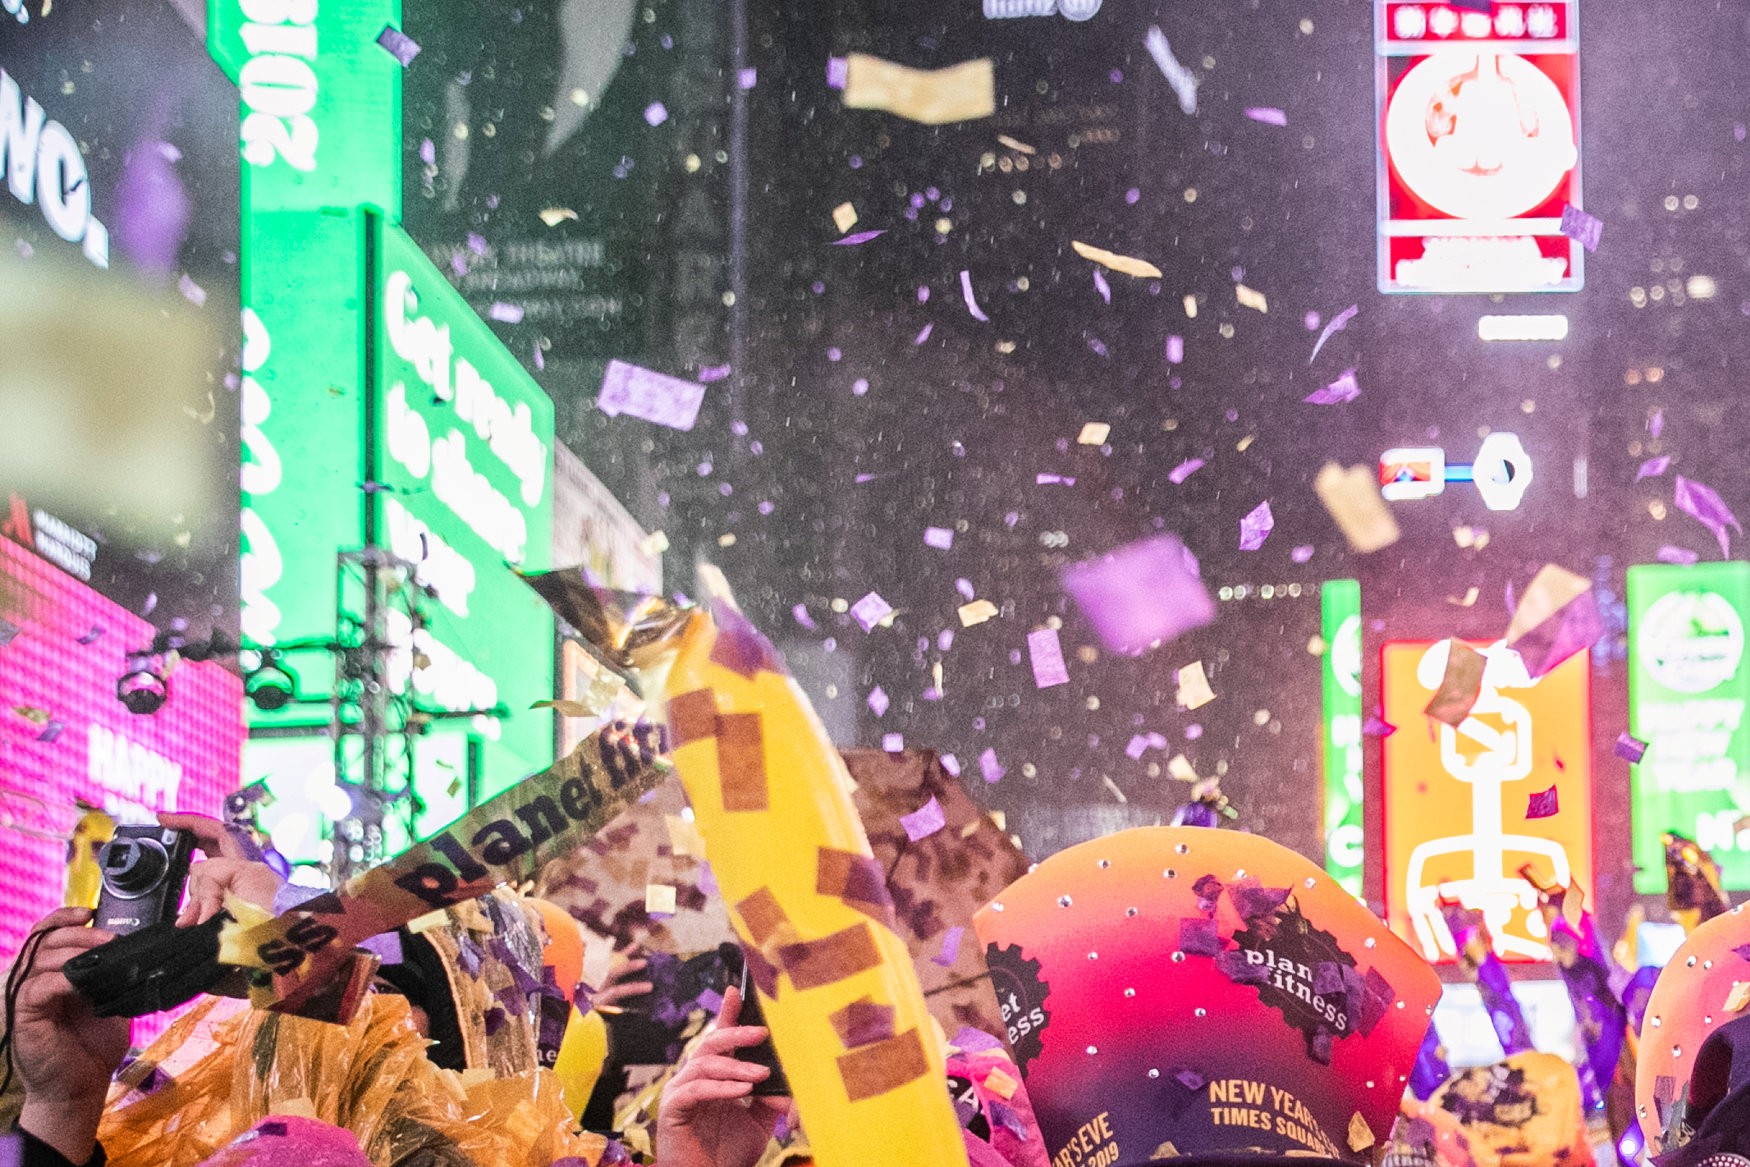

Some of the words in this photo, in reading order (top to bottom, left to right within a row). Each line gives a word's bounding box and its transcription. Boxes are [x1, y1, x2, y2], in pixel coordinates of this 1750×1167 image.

[1244, 948, 1314, 983] plan
[1209, 1079, 1266, 1105] NEW
[1211, 1107, 1272, 1131] TIMES
